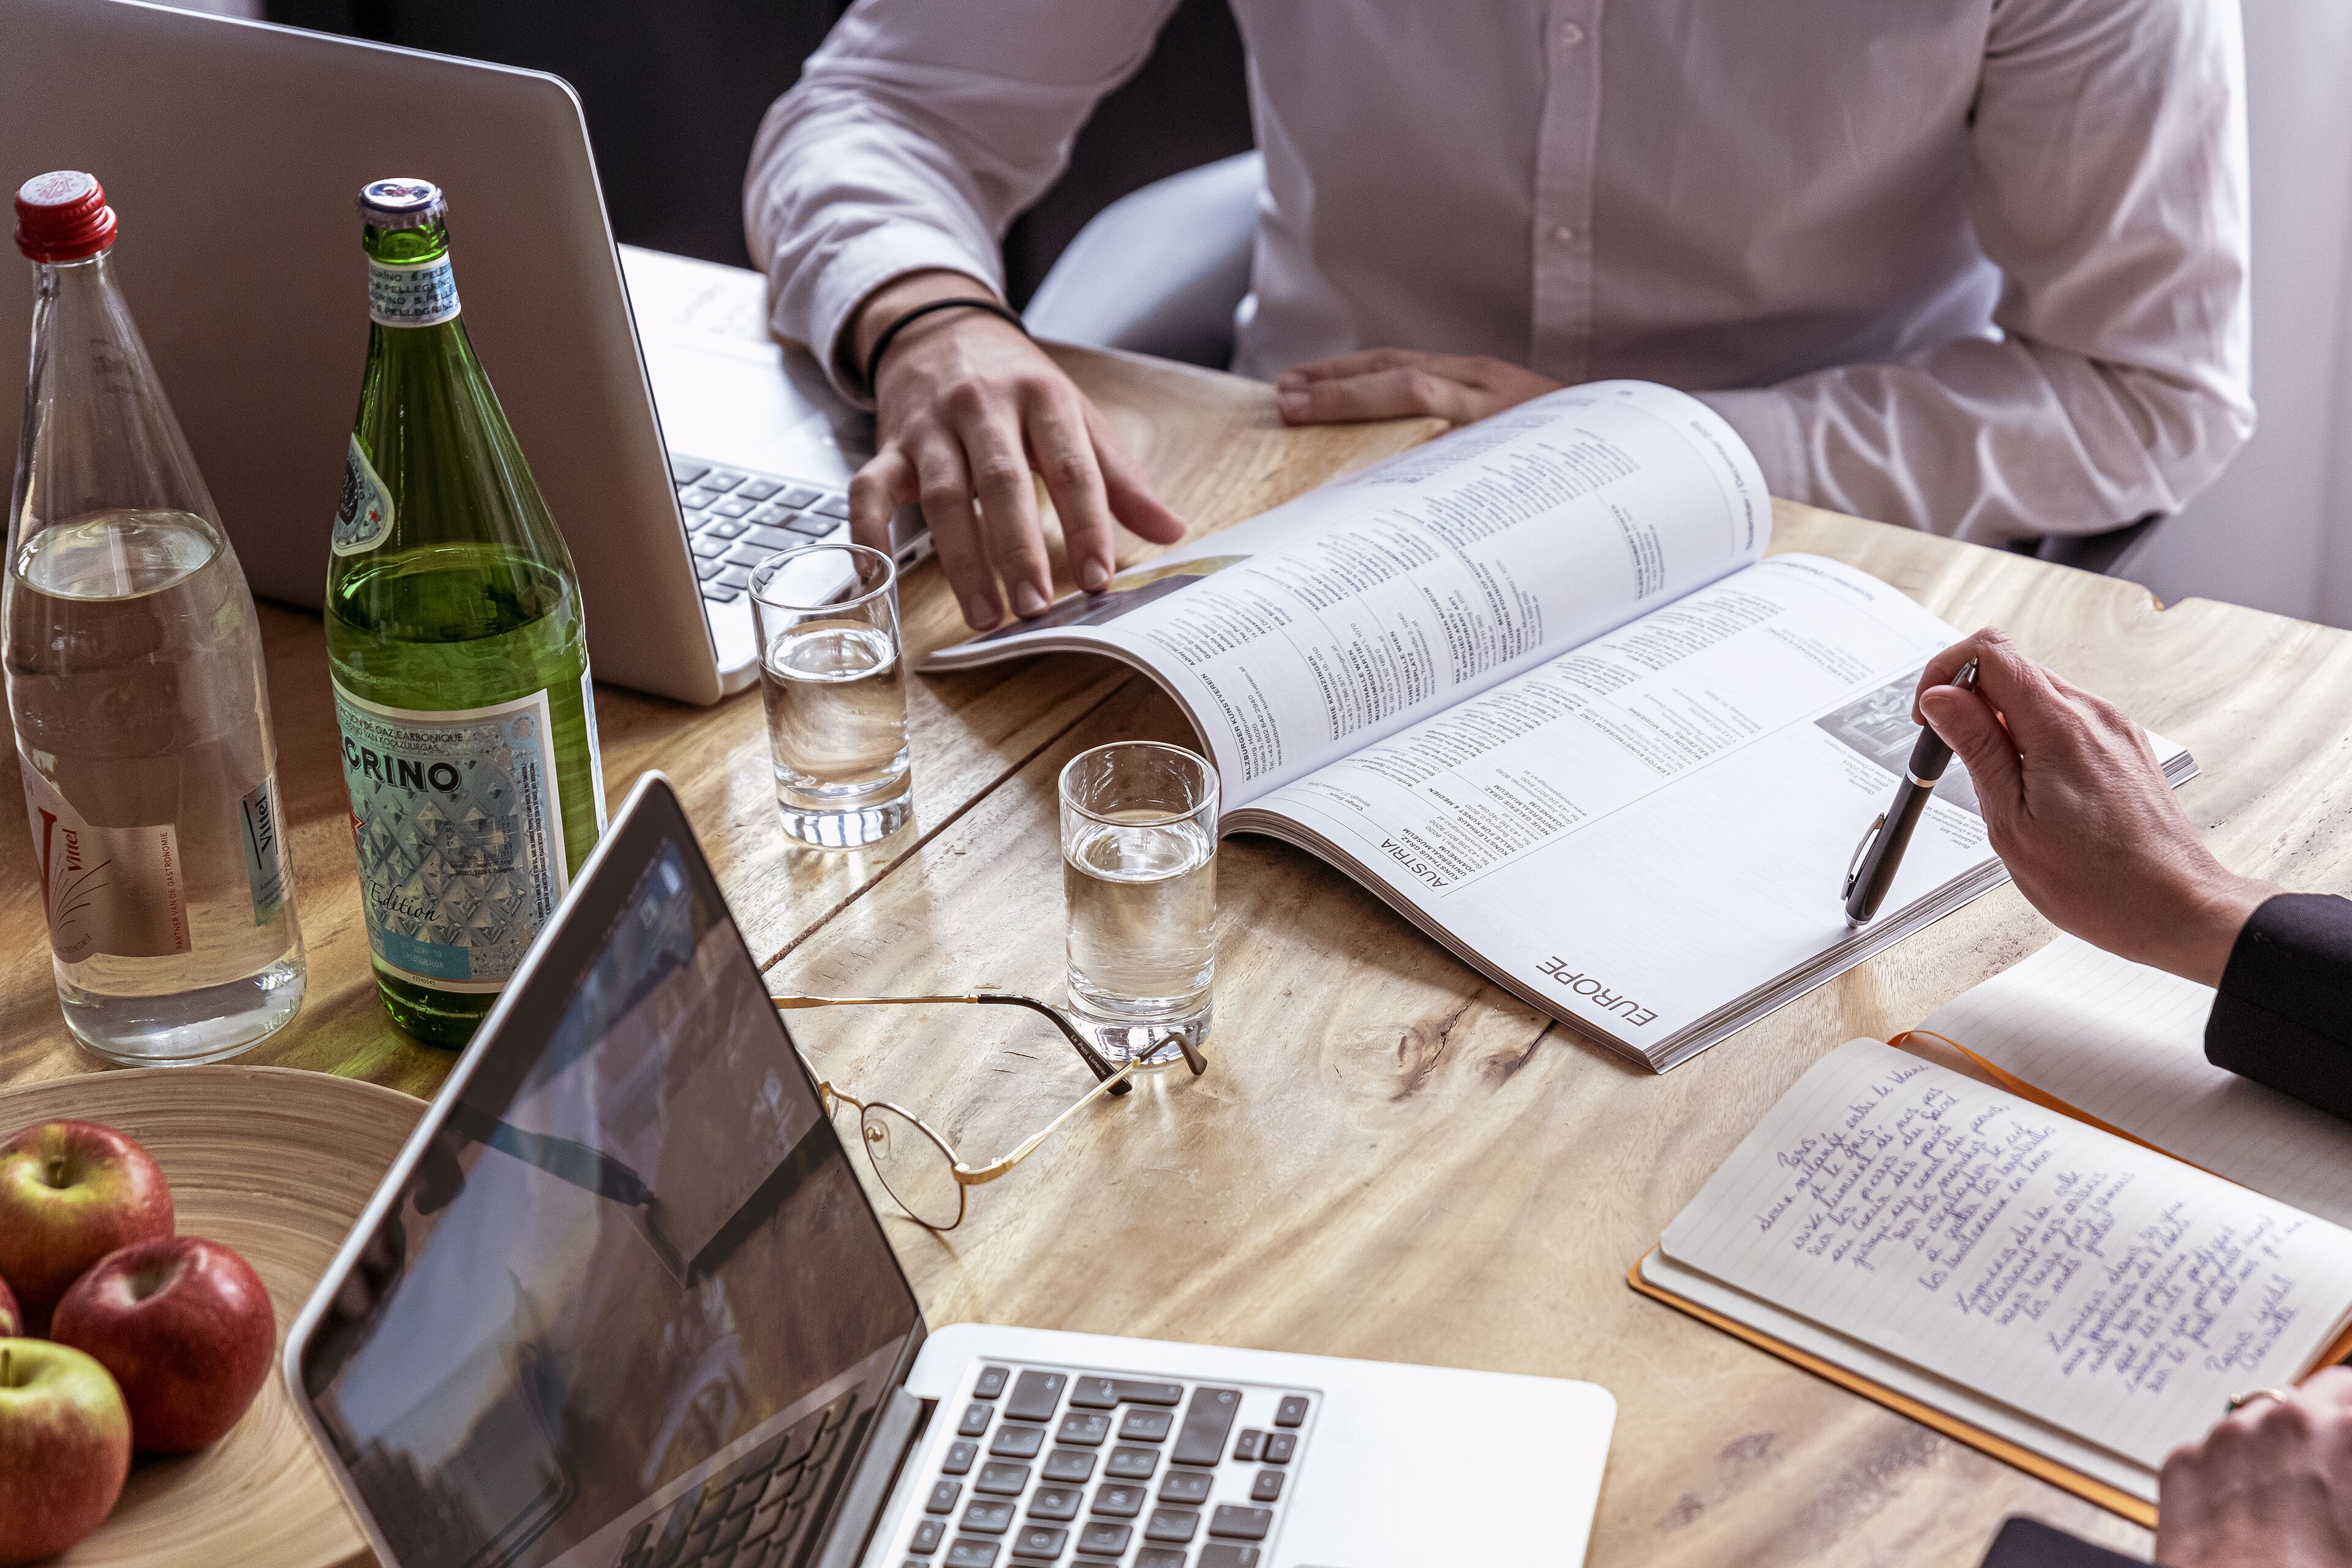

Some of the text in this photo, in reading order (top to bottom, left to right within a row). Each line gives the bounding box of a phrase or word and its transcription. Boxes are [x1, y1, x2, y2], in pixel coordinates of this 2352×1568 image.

[1458, 550, 1482, 578] MODERN
[1479, 562, 1507, 611] FOUNDATION
[1423, 587, 1446, 619] MUSEUM
[1487, 591, 1504, 626] MUSEUM
[1350, 623, 1363, 638] 1070
[1443, 620, 1460, 660] AUSTRIAN
[1449, 612, 1468, 668] APPLIED ARTS
[1457, 613, 1475, 677] CONTEMPORARY
[1504, 611, 1514, 644] LUDWIG
[1312, 647, 1324, 662] 1010
[1364, 644, 1385, 693] Museumsplatz
[1378, 635, 1403, 711] www.kunsthallewien.at
[1389, 631, 1414, 706] KUNSTHALLE WIEN
[1407, 651, 1420, 703] KARLSPLATZ
[1248, 695, 1261, 714] 2940
[1308, 655, 1339, 741] GALERIE KRINZINGER
[1331, 645, 1362, 730] www.galerie-krinzinger.at
[1348, 649, 1373, 725] KUNSTHALLE WIEN
[1352, 641, 1380, 722] MUSEUMSQUARTIER
[396, 730, 464, 743] CARBONIQUE
[1200, 673, 1251, 781] SALZBURGER KUNSTVEREIN
[1234, 705, 1254, 745] Hellbrunner
[1238, 666, 1282, 767] www.salzburger-kunstverein.at
[1251, 723, 1262, 742] 5020
[1627, 707, 1660, 729] MODERNE
[341, 736, 462, 793] GRINO
[1597, 723, 1671, 776] LENTOS KUNSTMUSEUM
[1673, 739, 1703, 760] MUSEUM
[1675, 731, 1710, 756] SALZBURG
[1391, 767, 1421, 784] Immersion
[1495, 768, 1573, 824] Graz, Joanneumsviertel, 8010
[1520, 777, 1536, 788] 9100
[1523, 770, 1588, 817] www.neuegaleriegraz.at
[1349, 794, 1371, 807] through
[1427, 788, 1517, 853] HALLE FÜR KUNST MEDIEN
[1484, 785, 1550, 836] NEUE GALERIE GRAZ,
[1493, 784, 1558, 832] UNIVERSALMUSEUM
[1529, 801, 1566, 828] JOANNEUM
[255, 794, 273, 854] Vittel
[1429, 820, 1446, 832] 9200
[1436, 815, 1498, 861] www.kunsthausgraz.at
[1457, 816, 1509, 856] KÜNSTLERHAUS,
[1464, 804, 1525, 848] Graz, Burgring 8010
[62, 827, 83, 872] Vittel
[1381, 838, 1449, 889] AUSTRIA
[1400, 834, 1460, 881] KUNSTHAUS GRAZ,
[1402, 827, 1467, 876] UNIVERSALMUSEUM
[1425, 826, 1482, 869] Graz, Lendkai 8020
[1438, 845, 1476, 873] JOANNEUM
[159, 831, 184, 950] PARTNER VAN DE GASTRONOMIE
[369, 879, 441, 921] Edition
[1535, 956, 1659, 1027] EUROPE
